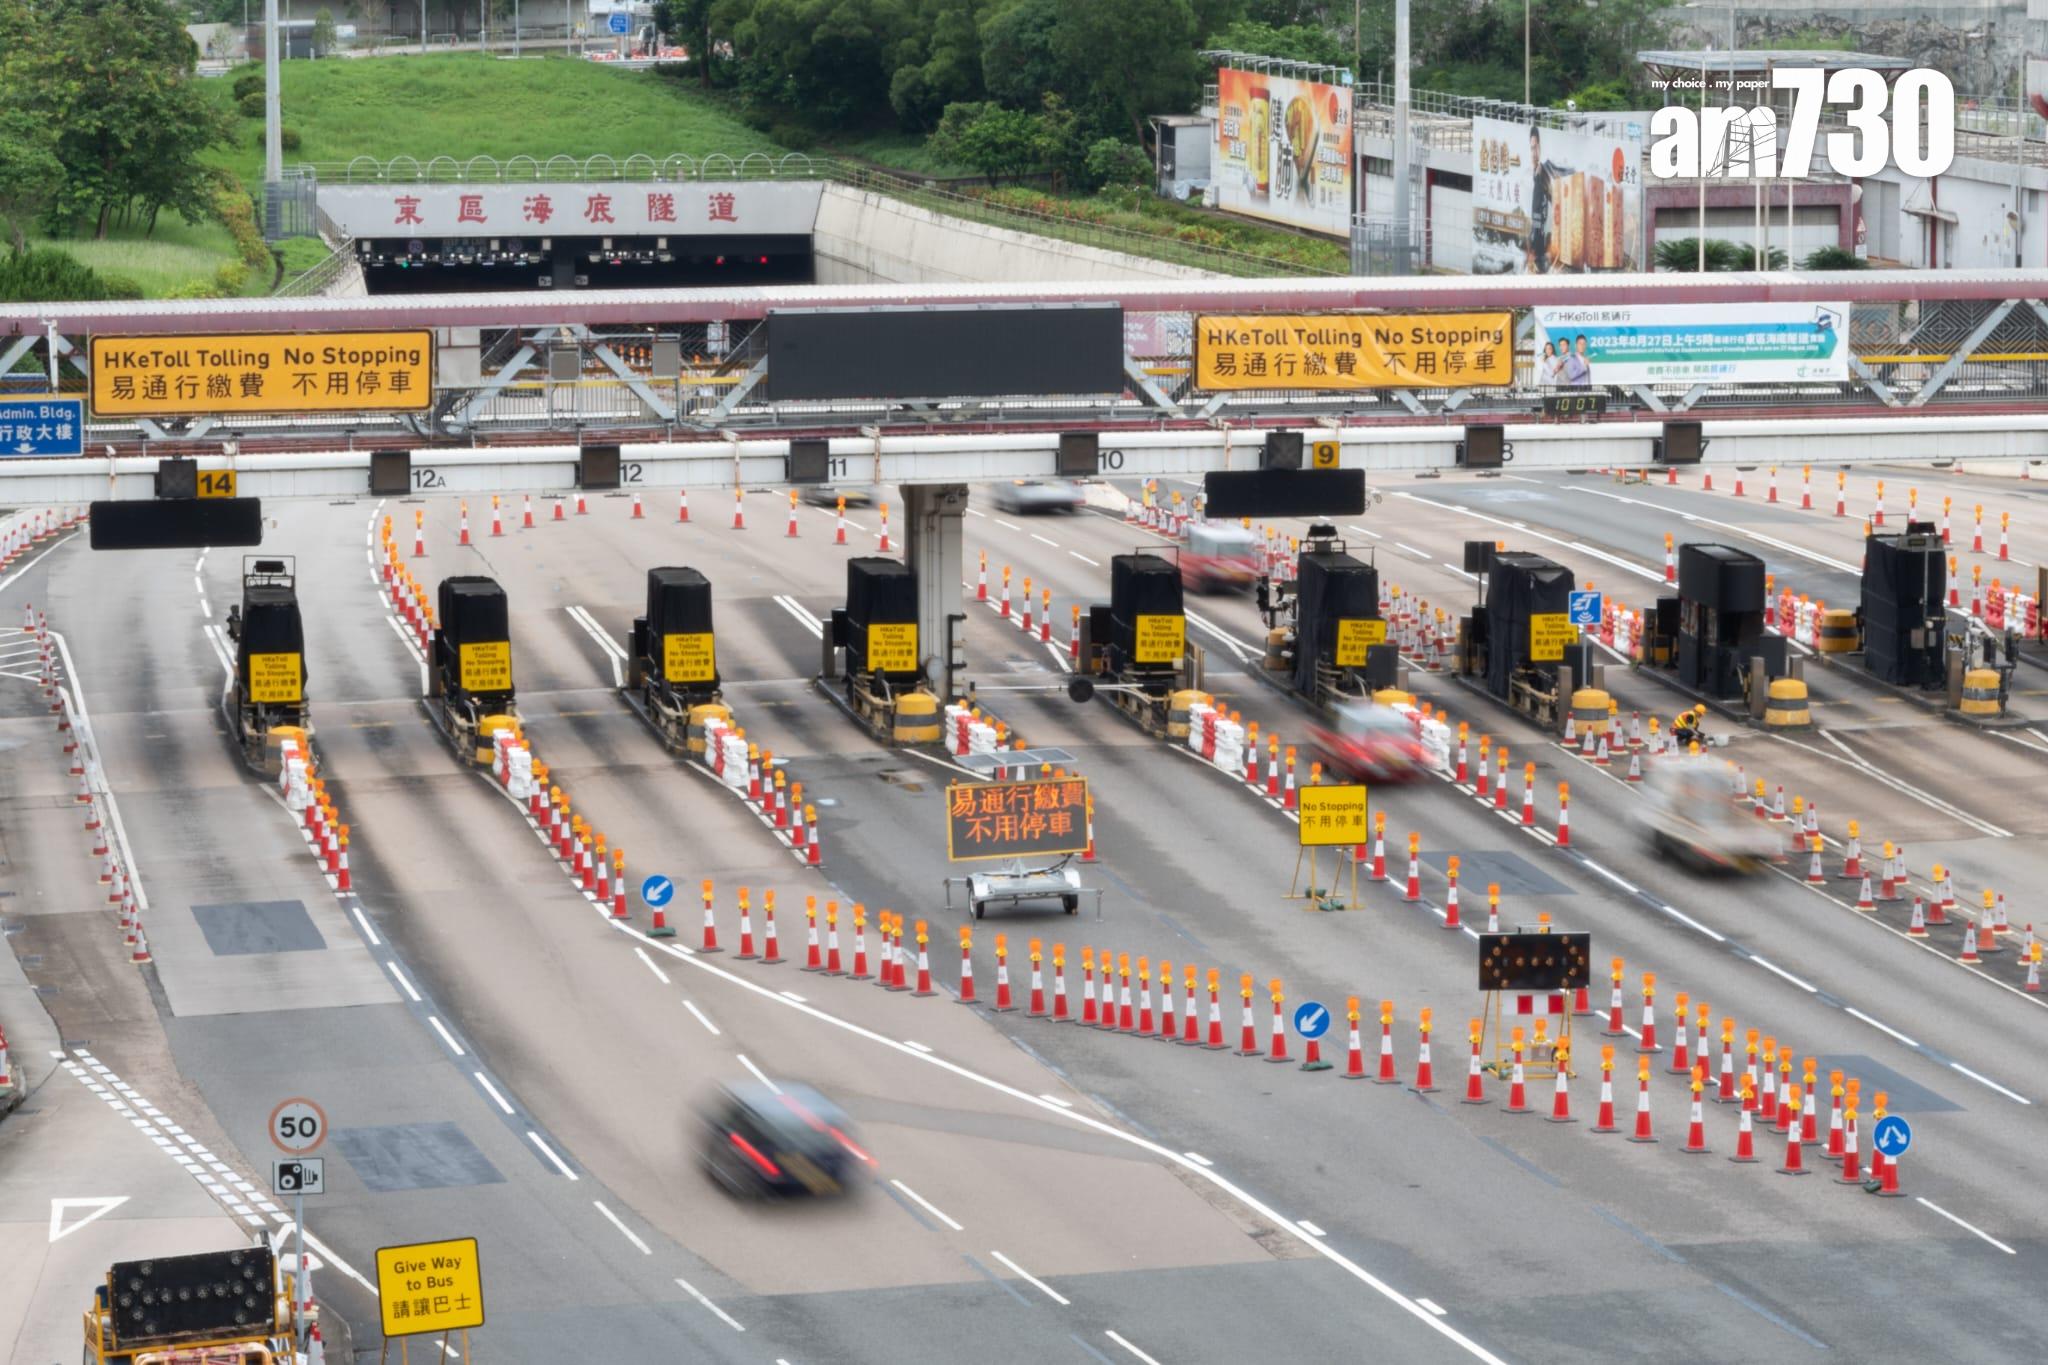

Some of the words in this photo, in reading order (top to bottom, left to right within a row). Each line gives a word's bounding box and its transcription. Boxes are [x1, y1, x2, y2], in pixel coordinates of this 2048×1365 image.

[394, 192, 739, 225] 東區海底隧道
[1559, 312, 1599, 322] HKeToll
[1208, 329, 1288, 346] HKeToll
[1296, 328, 1362, 348] Tolling
[1375, 328, 1404, 345] No
[1411, 325, 1504, 347] Stopping
[105, 350, 190, 369] HKeToll
[196, 348, 270, 369] Tolling
[284, 347, 314, 366] No
[322, 346, 421, 367] Stopping
[1213, 352, 1357, 377] 易通行繳費
[1383, 349, 1497, 376] 不用停車
[111, 374, 265, 401] 易通行繳費
[292, 370, 413, 397] 不用停車
[40, 405, 76, 421] Bldg.
[0, 423, 73, 442] 行政大樓
[1098, 450, 1124, 470] 10
[1318, 444, 1334, 465] 9
[620, 464, 643, 483] 12
[829, 458, 847, 477] 11
[200, 473, 232, 494] 14
[411, 469, 446, 489] 12A
[952, 782, 1084, 818] 易通行繳費
[1303, 803, 1317, 811] No
[1319, 802, 1364, 812] Stopping
[965, 811, 1073, 843] 不用停車
[1304, 815, 1364, 828] 不用停車
[281, 1117, 317, 1138] 50
[394, 1261, 426, 1274] Give
[431, 1257, 462, 1270] Way
[406, 1279, 421, 1291] to
[426, 1276, 454, 1289] Bus
[392, 1292, 472, 1319] 請讓巴士
